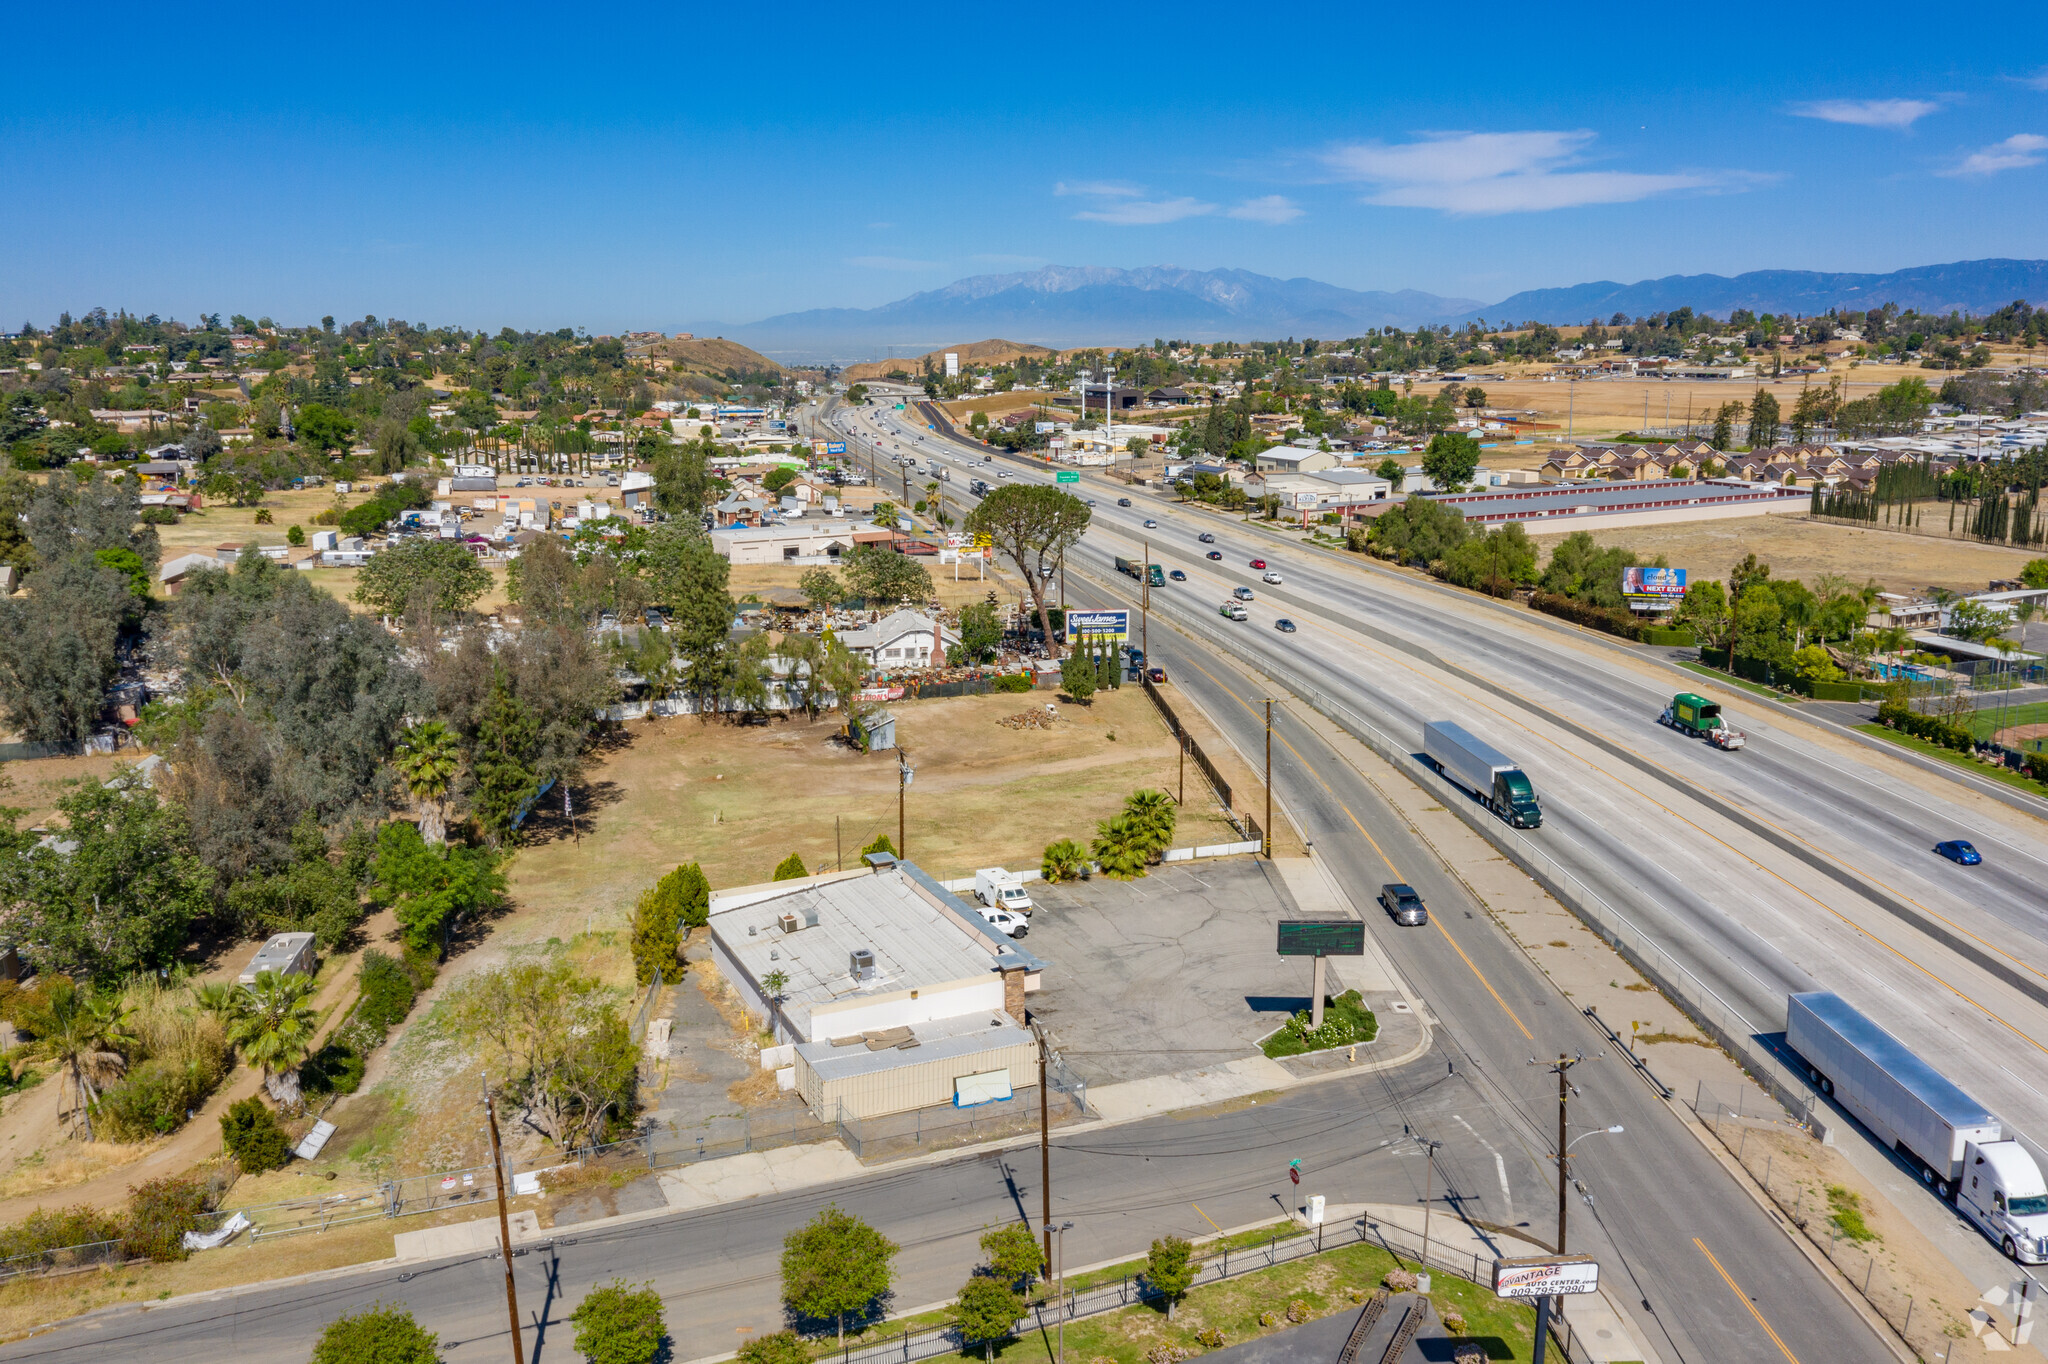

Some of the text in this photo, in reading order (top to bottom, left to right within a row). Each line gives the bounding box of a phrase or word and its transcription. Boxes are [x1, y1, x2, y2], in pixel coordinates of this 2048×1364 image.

[1070, 614, 1093, 623] Sweet
[1500, 1267, 1561, 1289] ADVANTAGE
[1510, 1285, 1585, 1296] 909-795-7990
